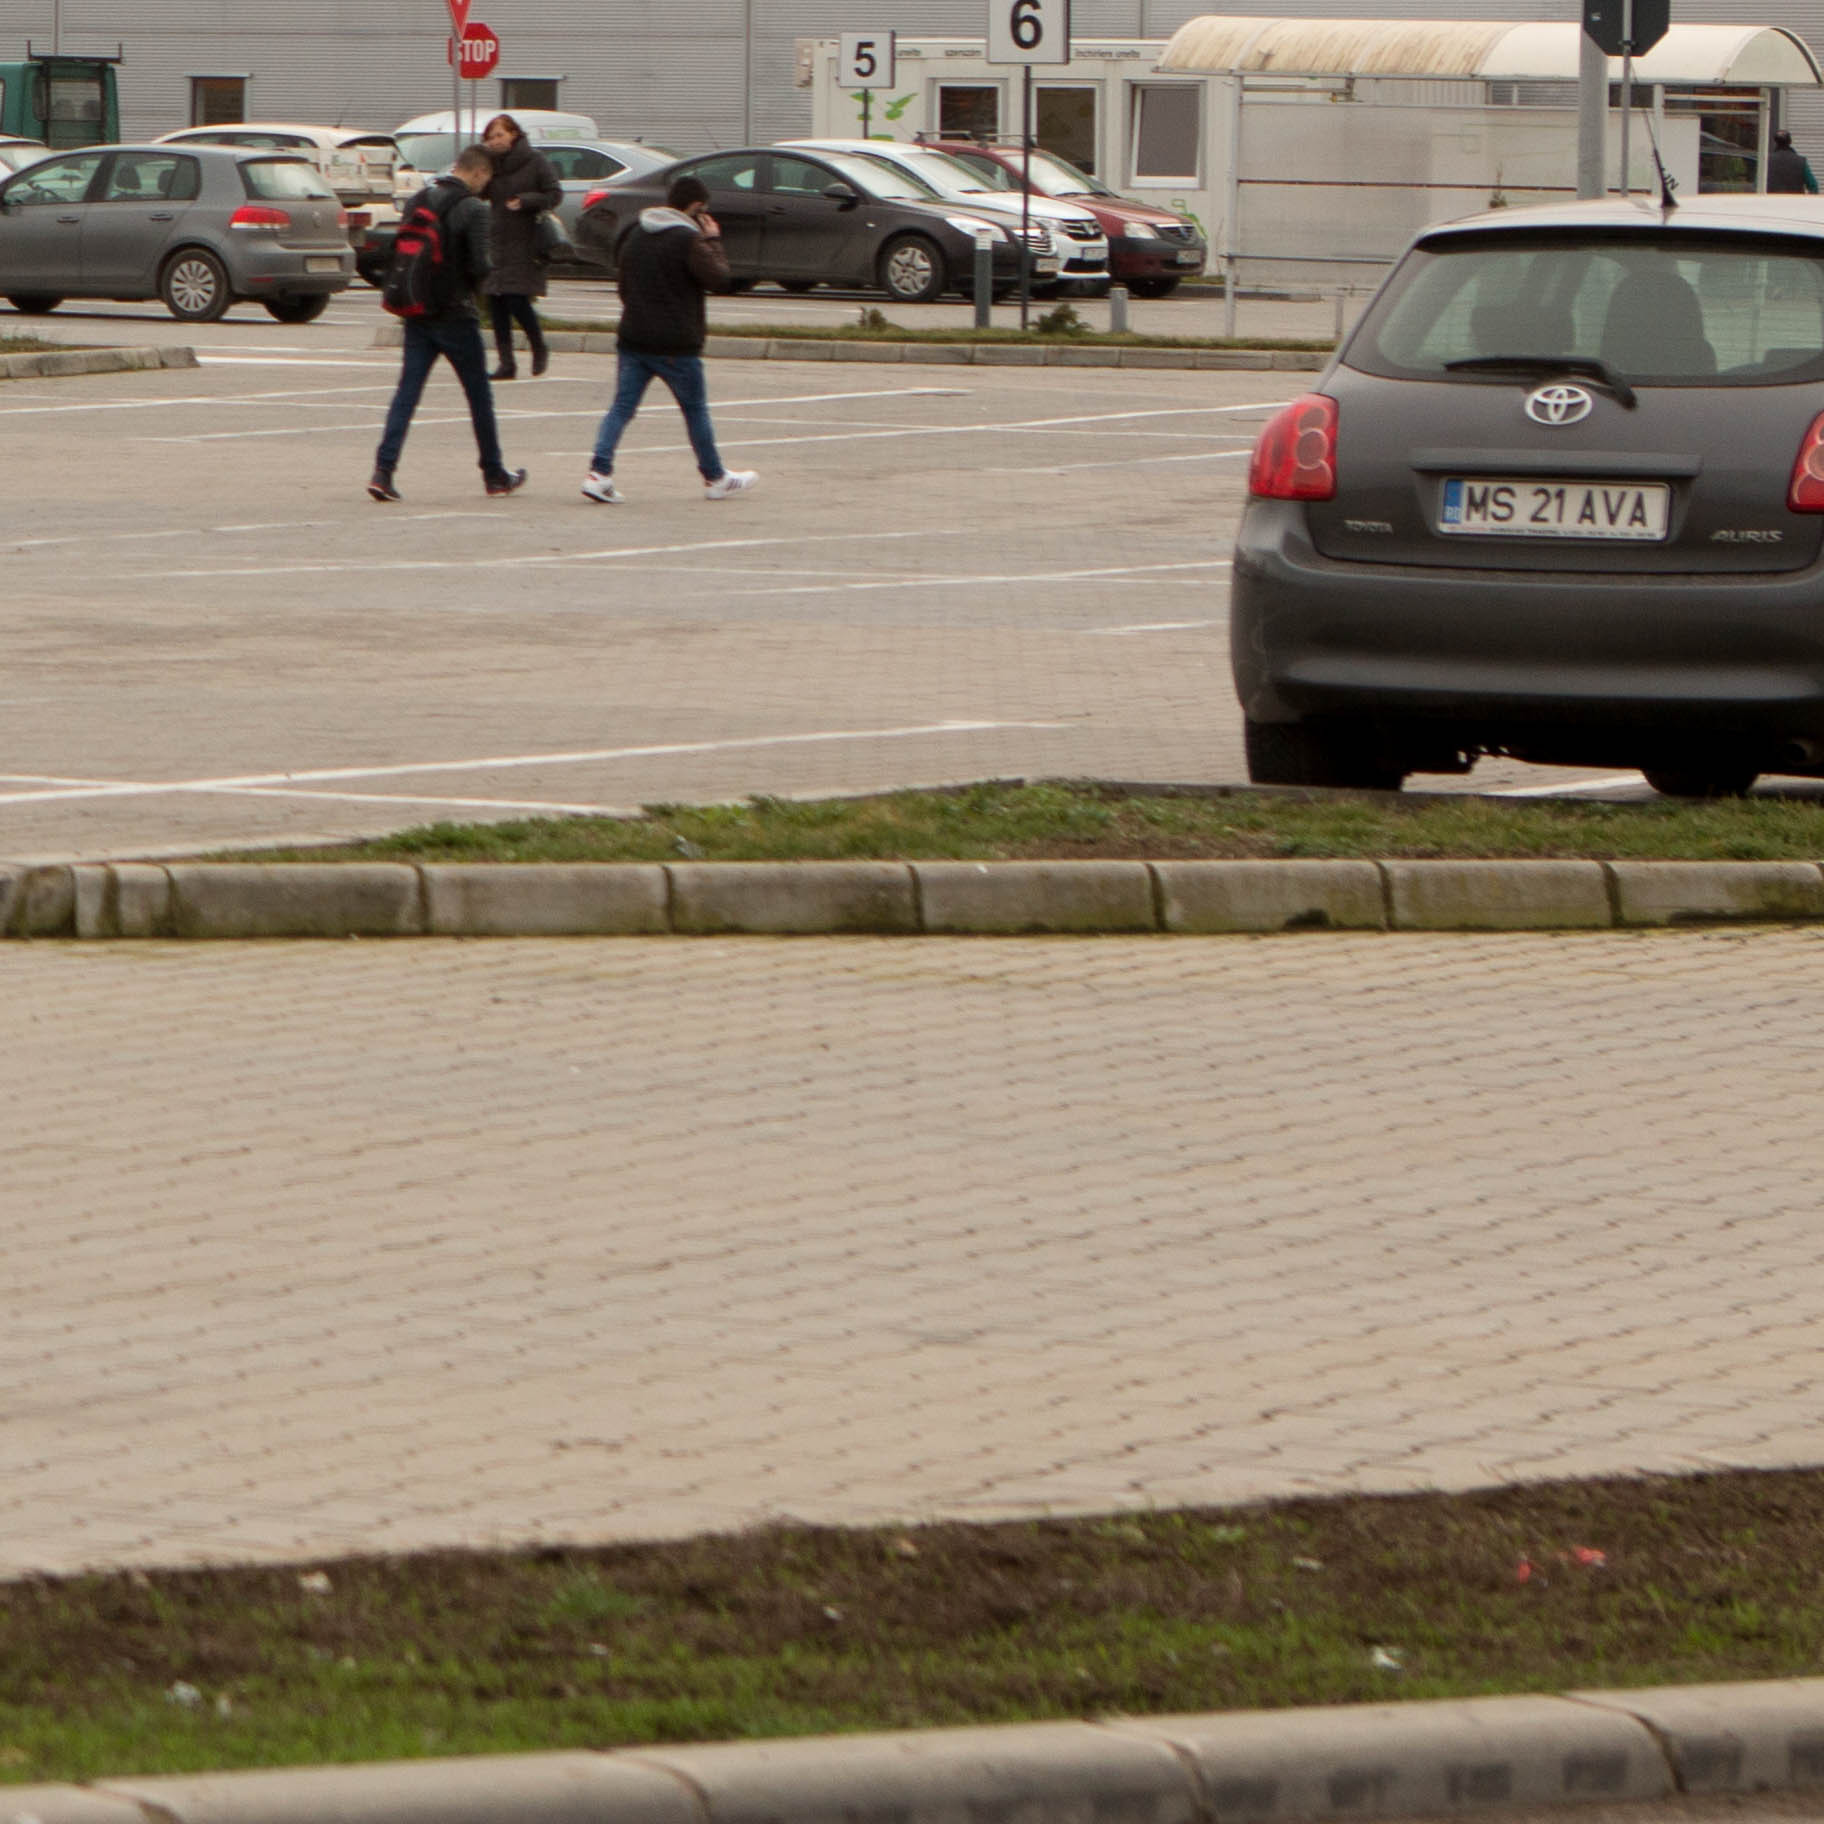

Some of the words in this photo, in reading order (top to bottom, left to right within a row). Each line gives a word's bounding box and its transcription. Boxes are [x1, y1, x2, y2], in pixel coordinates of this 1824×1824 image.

[854, 41, 877, 78] 5
[1465, 485, 1516, 522] MS
[1528, 487, 1565, 523] 21
[1577, 489, 1649, 528] AVA
